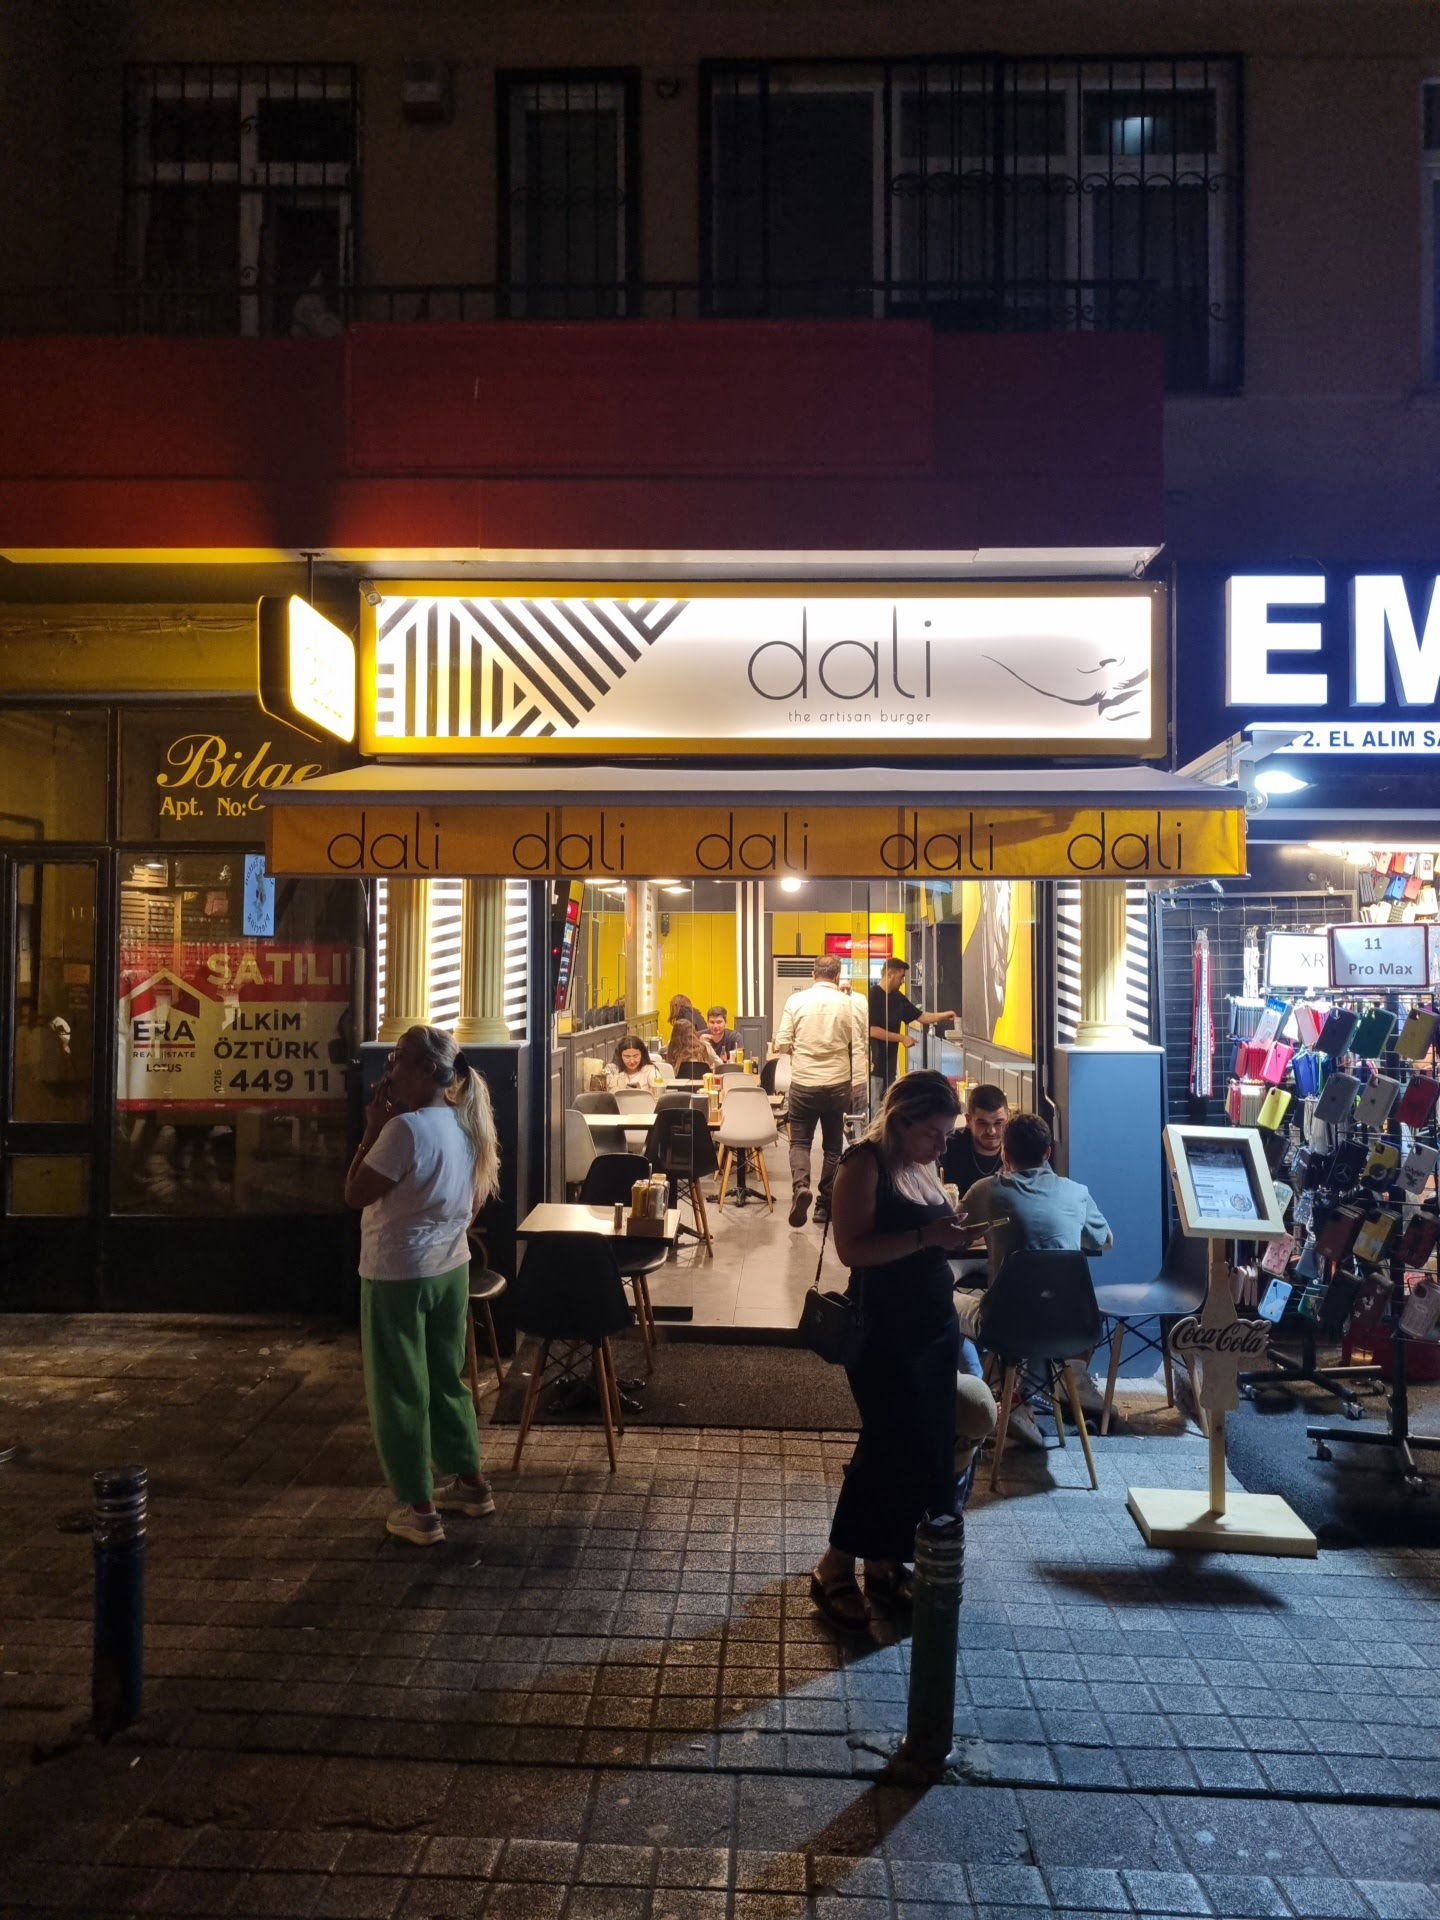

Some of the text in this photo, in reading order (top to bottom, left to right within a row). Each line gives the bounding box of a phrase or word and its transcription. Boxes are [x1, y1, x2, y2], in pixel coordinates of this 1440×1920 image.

[1226, 574, 1440, 707] EM
[748, 605, 932, 700] dali
[788, 710, 931, 725] the artisan burger
[1303, 731, 1320, 747] 2.
[1329, 731, 1354, 747] EL
[1362, 731, 1415, 747] ALIM
[1423, 730, 1440, 747] S
[159, 796, 204, 821] Apt.
[327, 811, 1182, 870] dali dali dali dali dali
[1364, 937, 1383, 950] 11
[1300, 953, 1325, 967] XR
[1348, 963, 1413, 975] Pro Max
[213, 1037, 320, 1060] ÖZTÜRK
[229, 1069, 294, 1093] 449
[1172, 1319, 1269, 1353] Coca-Cola
